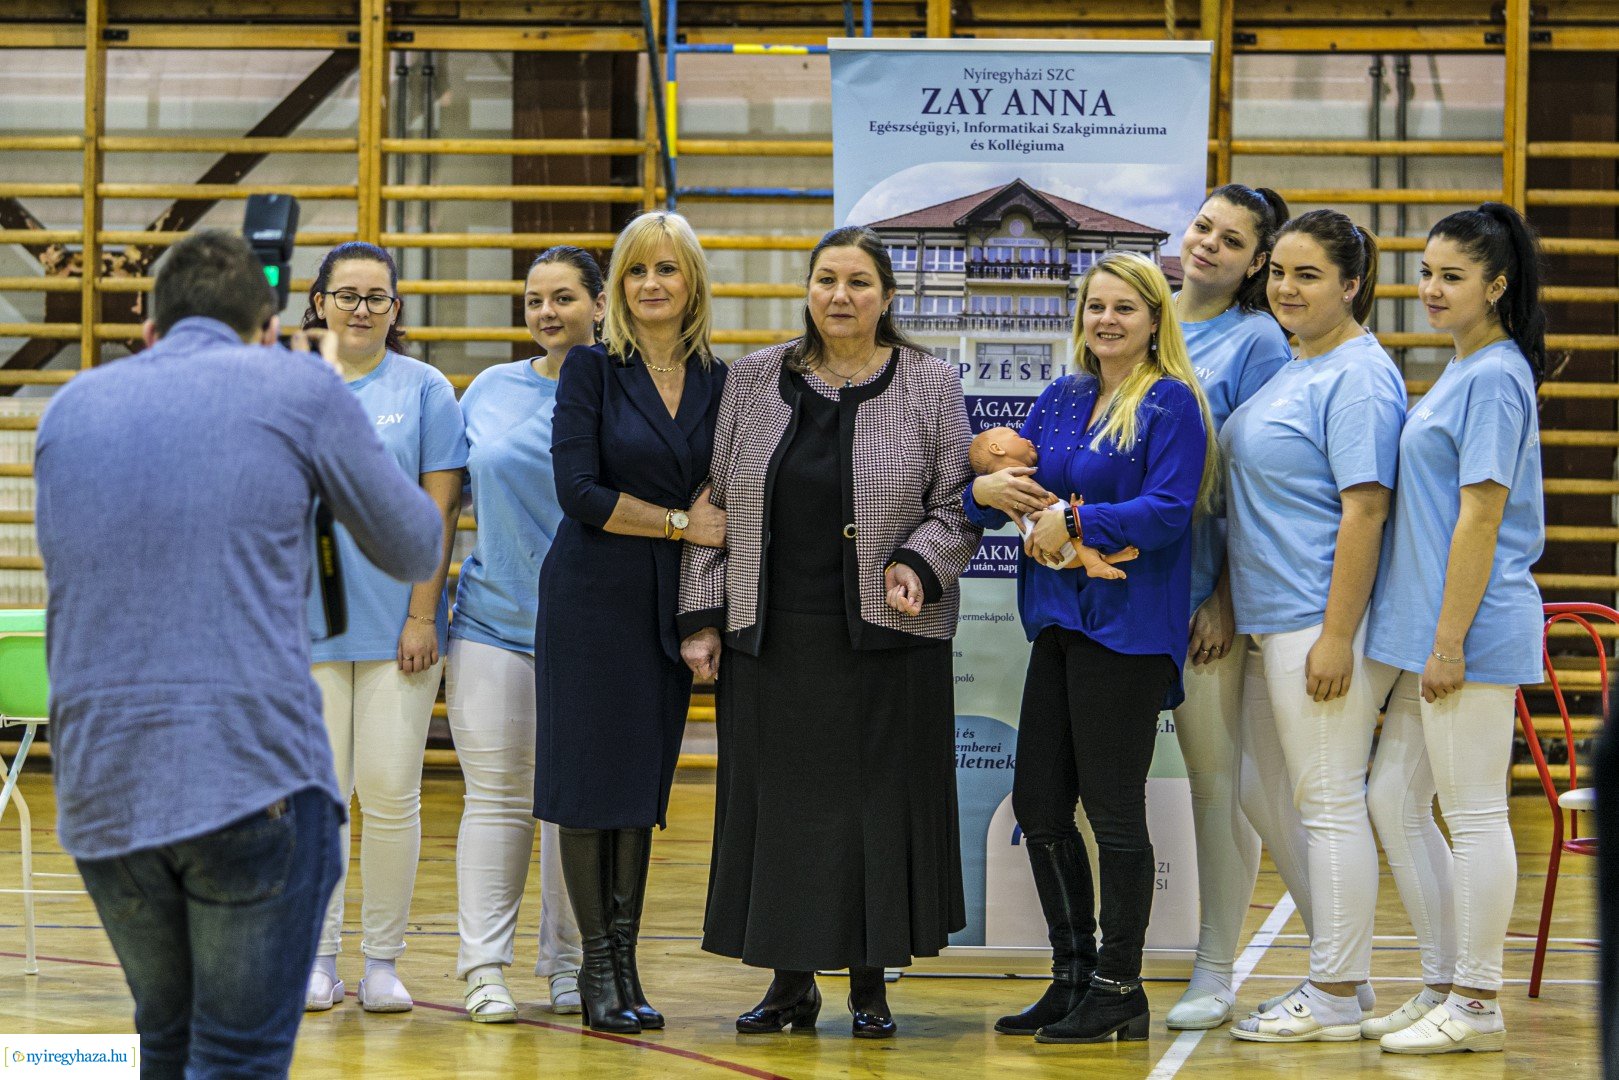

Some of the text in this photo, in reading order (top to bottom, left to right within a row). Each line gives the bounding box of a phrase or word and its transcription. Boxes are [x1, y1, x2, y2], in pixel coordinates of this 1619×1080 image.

[963, 67, 1075, 84] Nyíregyházi SZC
[921, 87, 1116, 117] ZAY ANNA
[869, 120, 1167, 137] Egészségügyi, Informatikai Szakgimnáziuma
[970, 139, 1064, 154] és Kollégiuma
[958, 359, 1068, 380] PZÉSEI
[376, 413, 404, 425] ZAY
[971, 544, 1019, 561] AKM
[973, 561, 996, 572] után,
[953, 673, 975, 685] poló
[962, 728, 975, 739] és
[1156, 862, 1170, 873] ZI
